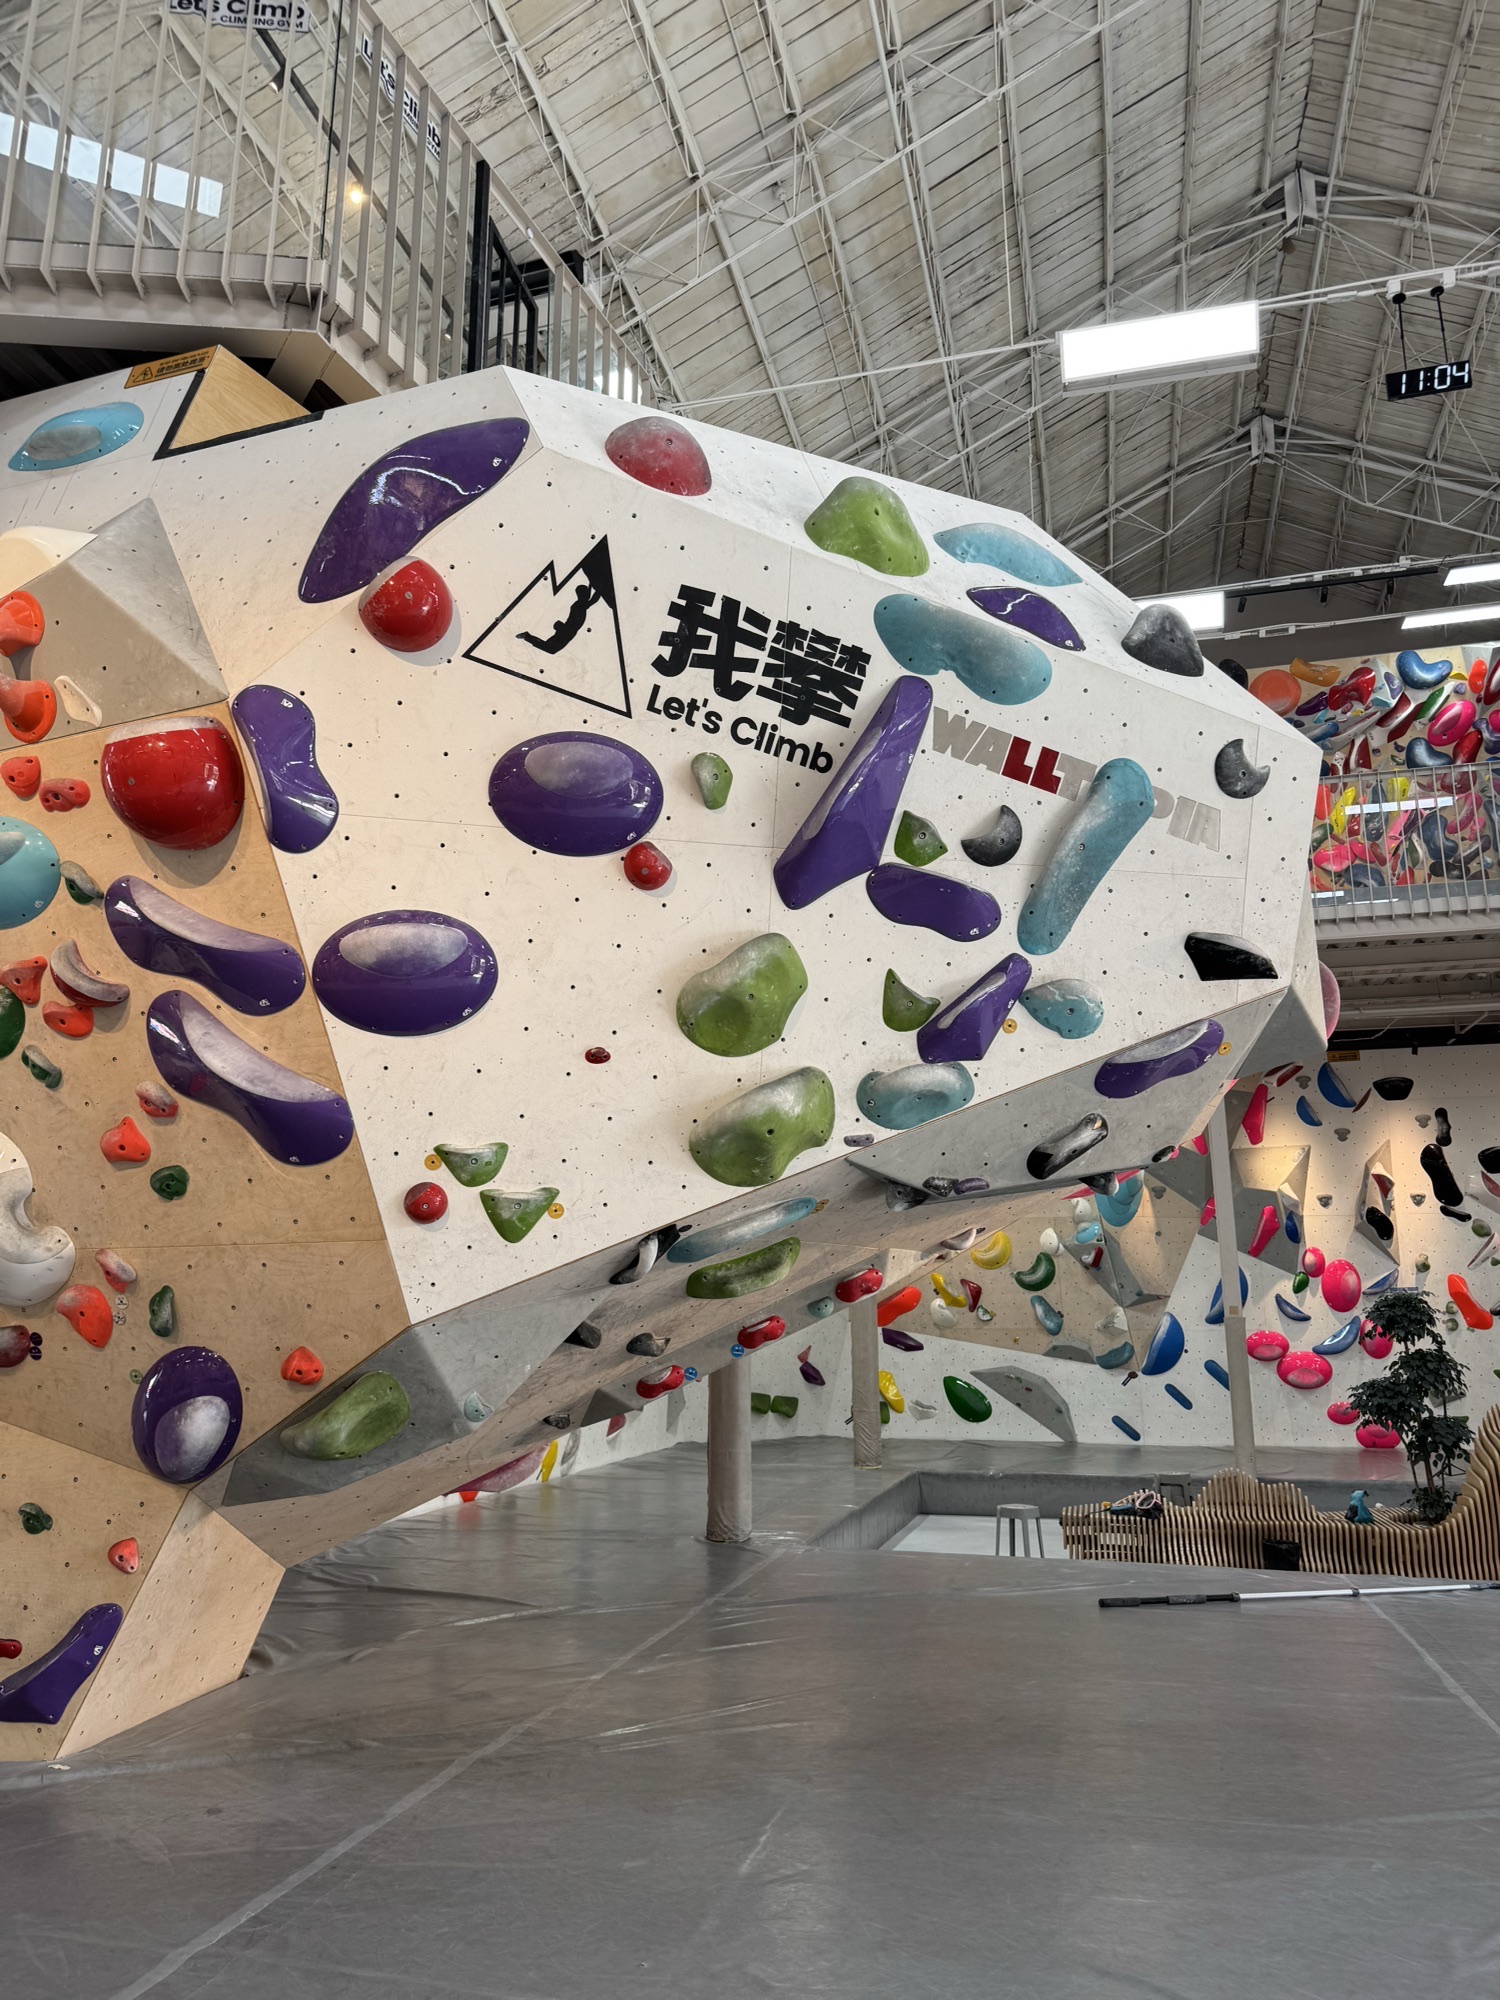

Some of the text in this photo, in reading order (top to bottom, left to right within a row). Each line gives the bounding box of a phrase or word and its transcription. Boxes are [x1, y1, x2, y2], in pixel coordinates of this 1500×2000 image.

[170, 0, 220, 13] Lets
[220, 15, 274, 26] CLIMING
[1401, 362, 1469, 394] 11:04
[646, 683, 833, 773] Let's Climb
